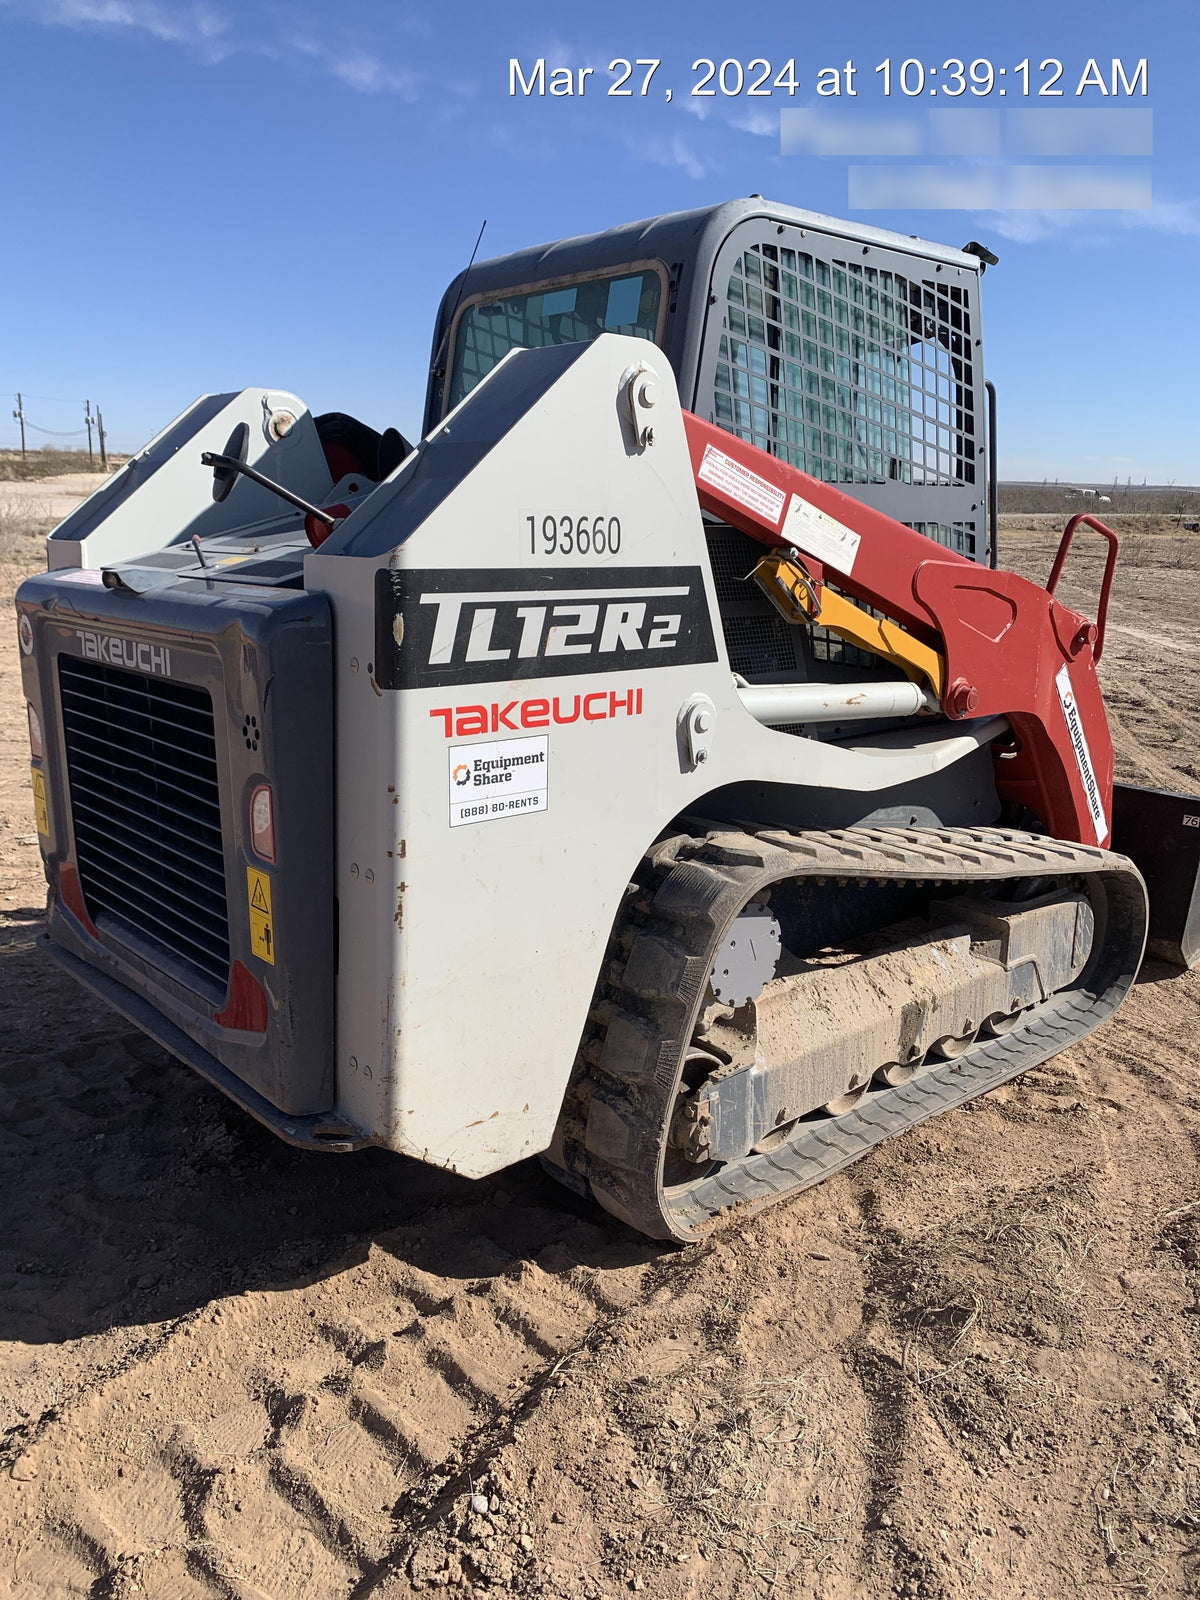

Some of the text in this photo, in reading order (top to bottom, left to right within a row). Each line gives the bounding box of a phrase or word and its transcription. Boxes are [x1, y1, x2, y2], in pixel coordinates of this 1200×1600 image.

[724, 458, 750, 478] CUSTOMER
[749, 473, 785, 500] RESPONSIBILITY
[525, 515, 622, 555] 193660
[419, 586, 691, 665] TL12R2
[473, 751, 545, 773] Equipment
[1067, 706, 1100, 819] EquipmentShare
[473, 772, 512, 787] Share
[460, 796, 539, 819] (888) 80-RENTS
[1185, 816, 1198, 826] 76
